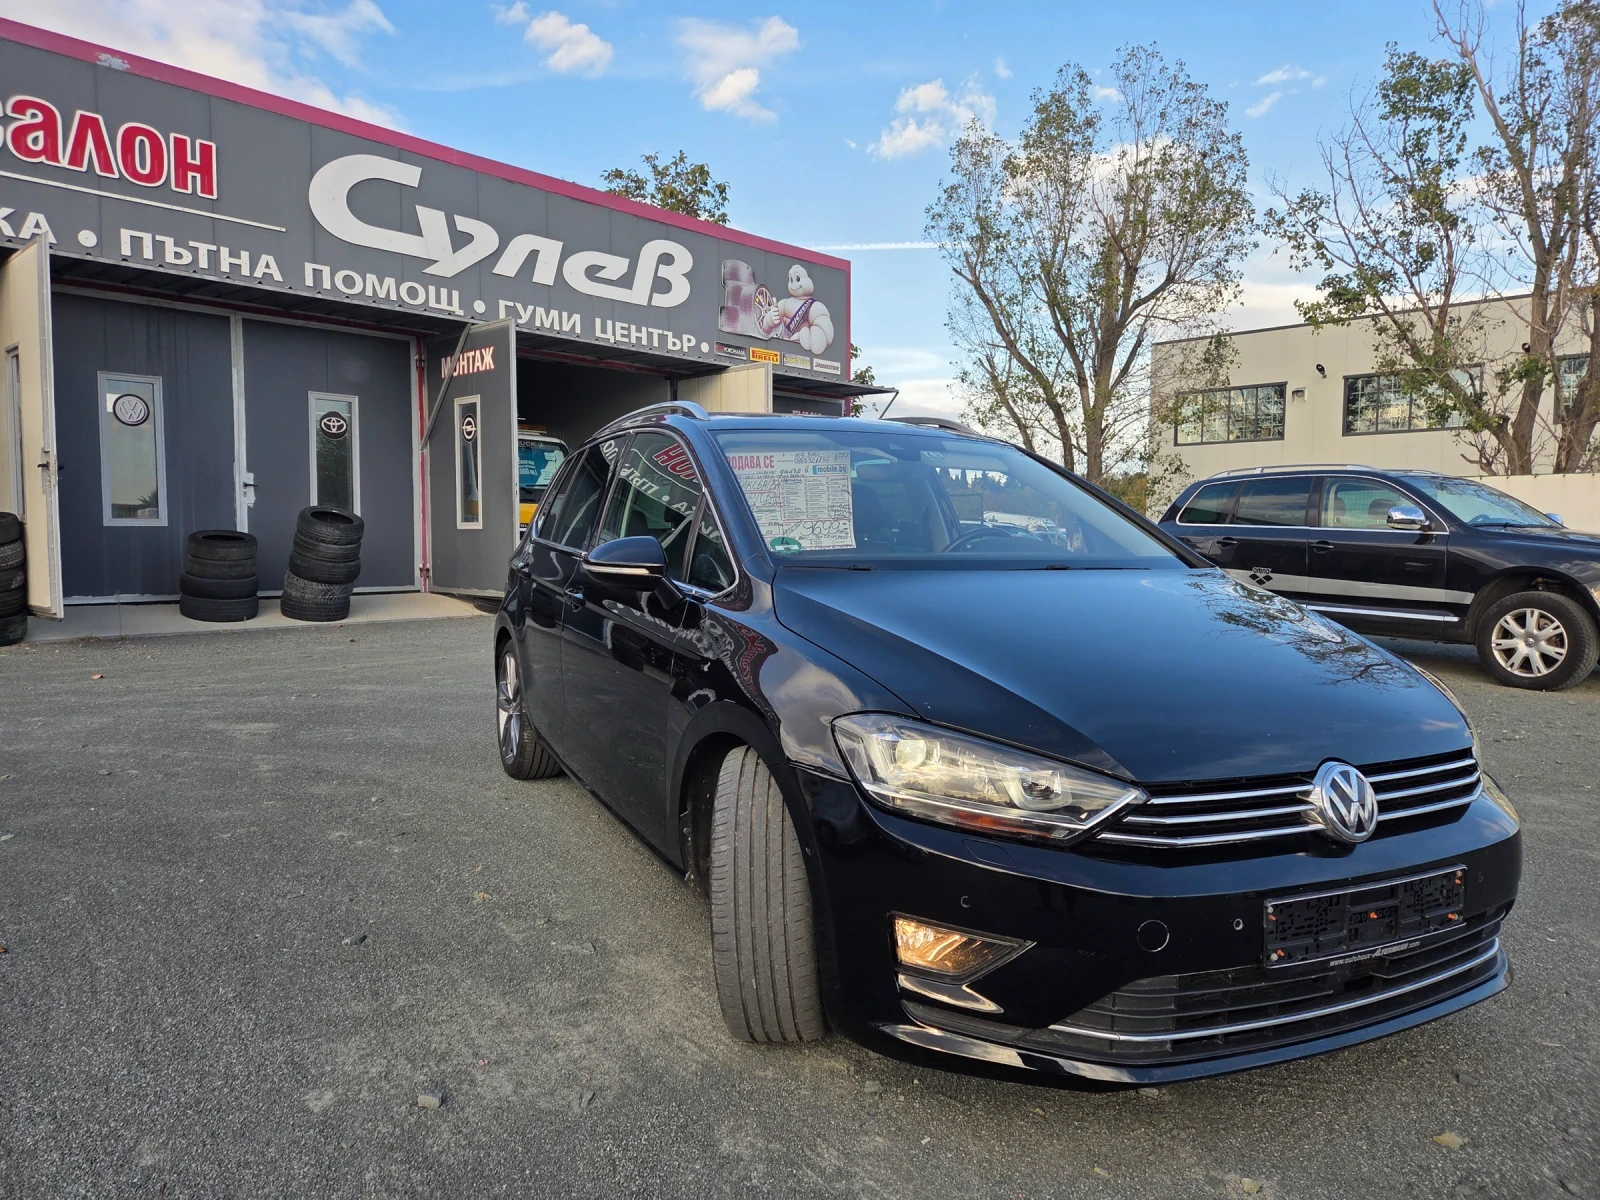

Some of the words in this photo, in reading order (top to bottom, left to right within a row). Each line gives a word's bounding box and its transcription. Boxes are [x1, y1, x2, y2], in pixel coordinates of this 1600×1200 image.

[0, 95, 217, 200] алон
[120, 227, 284, 283] ПЪТНА
[304, 261, 465, 317] ПОМОЩ
[498, 299, 581, 334] ГУМИ
[594, 317, 697, 354] ЦЕНТЪР
[723, 346, 746, 357] YOKOHAMA
[752, 350, 779, 363] PIRELLI
[727, 455, 761, 471] ОДАВА
[763, 455, 775, 469] СЕ
[817, 465, 847, 474] mobile.bg
[1252, 567, 1270, 575] arena
